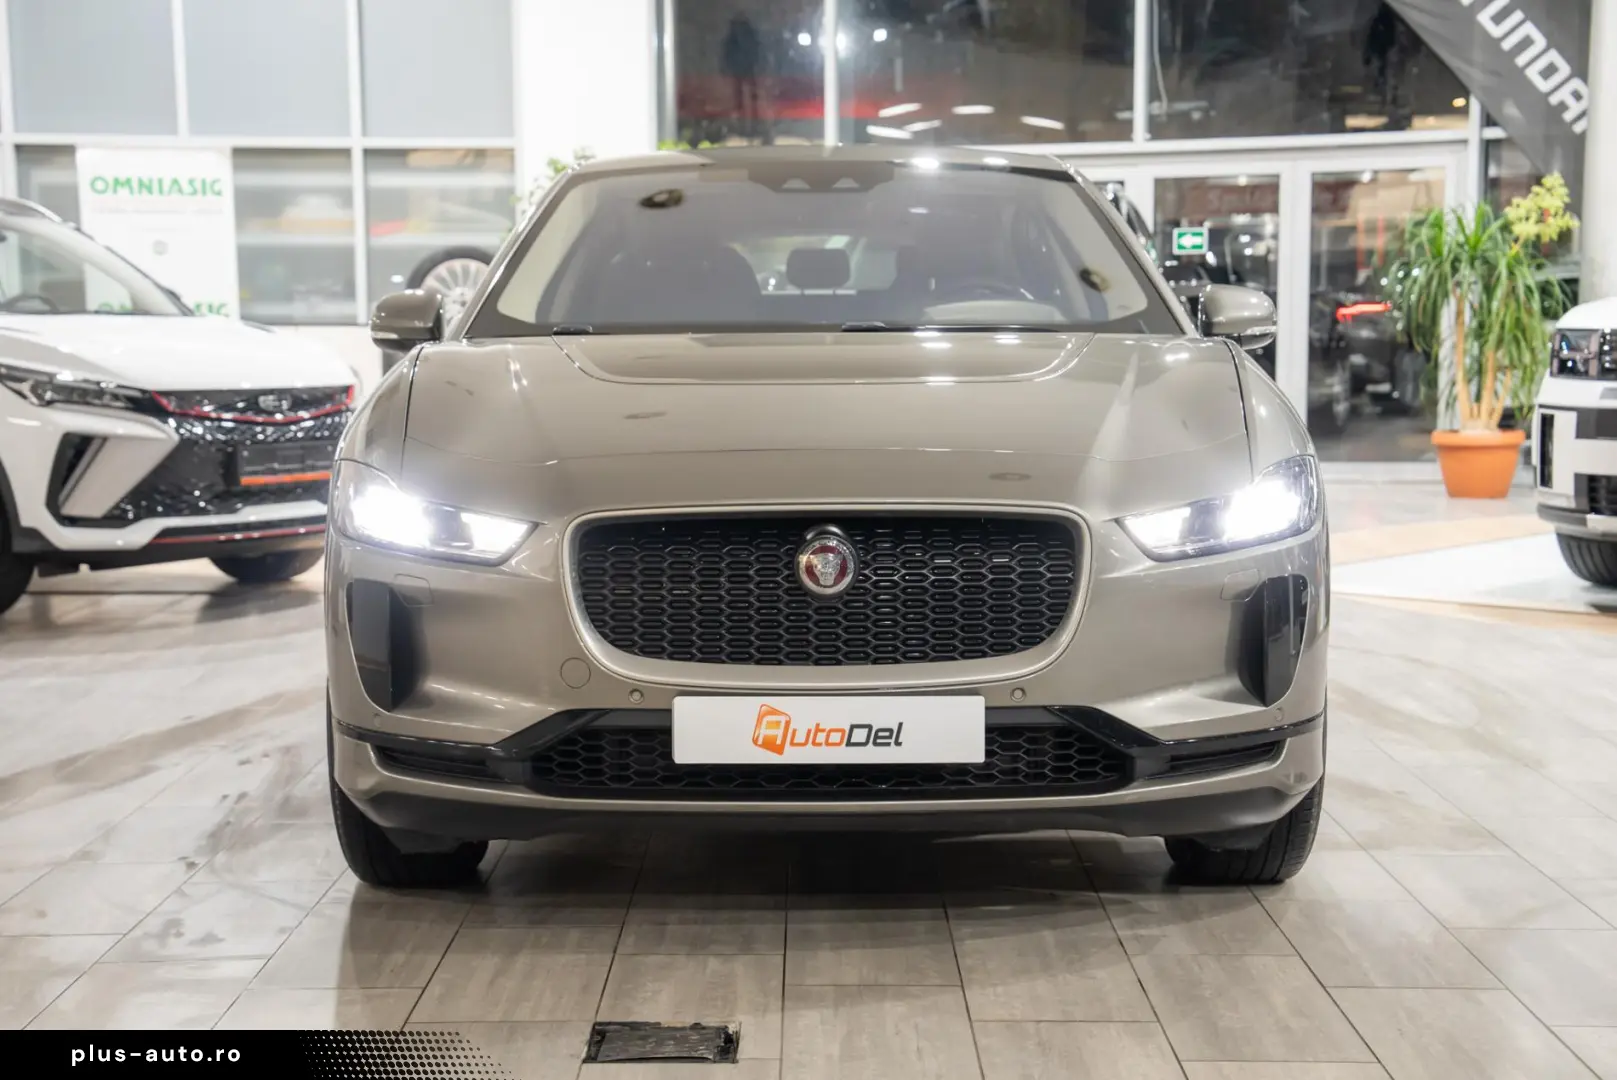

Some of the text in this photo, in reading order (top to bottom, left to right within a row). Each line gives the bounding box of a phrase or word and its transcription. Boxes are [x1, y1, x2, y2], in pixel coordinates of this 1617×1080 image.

[1457, 0, 1589, 135] UNDA
[90, 176, 223, 196] OMNIASIG
[753, 710, 904, 751] AutoDel
